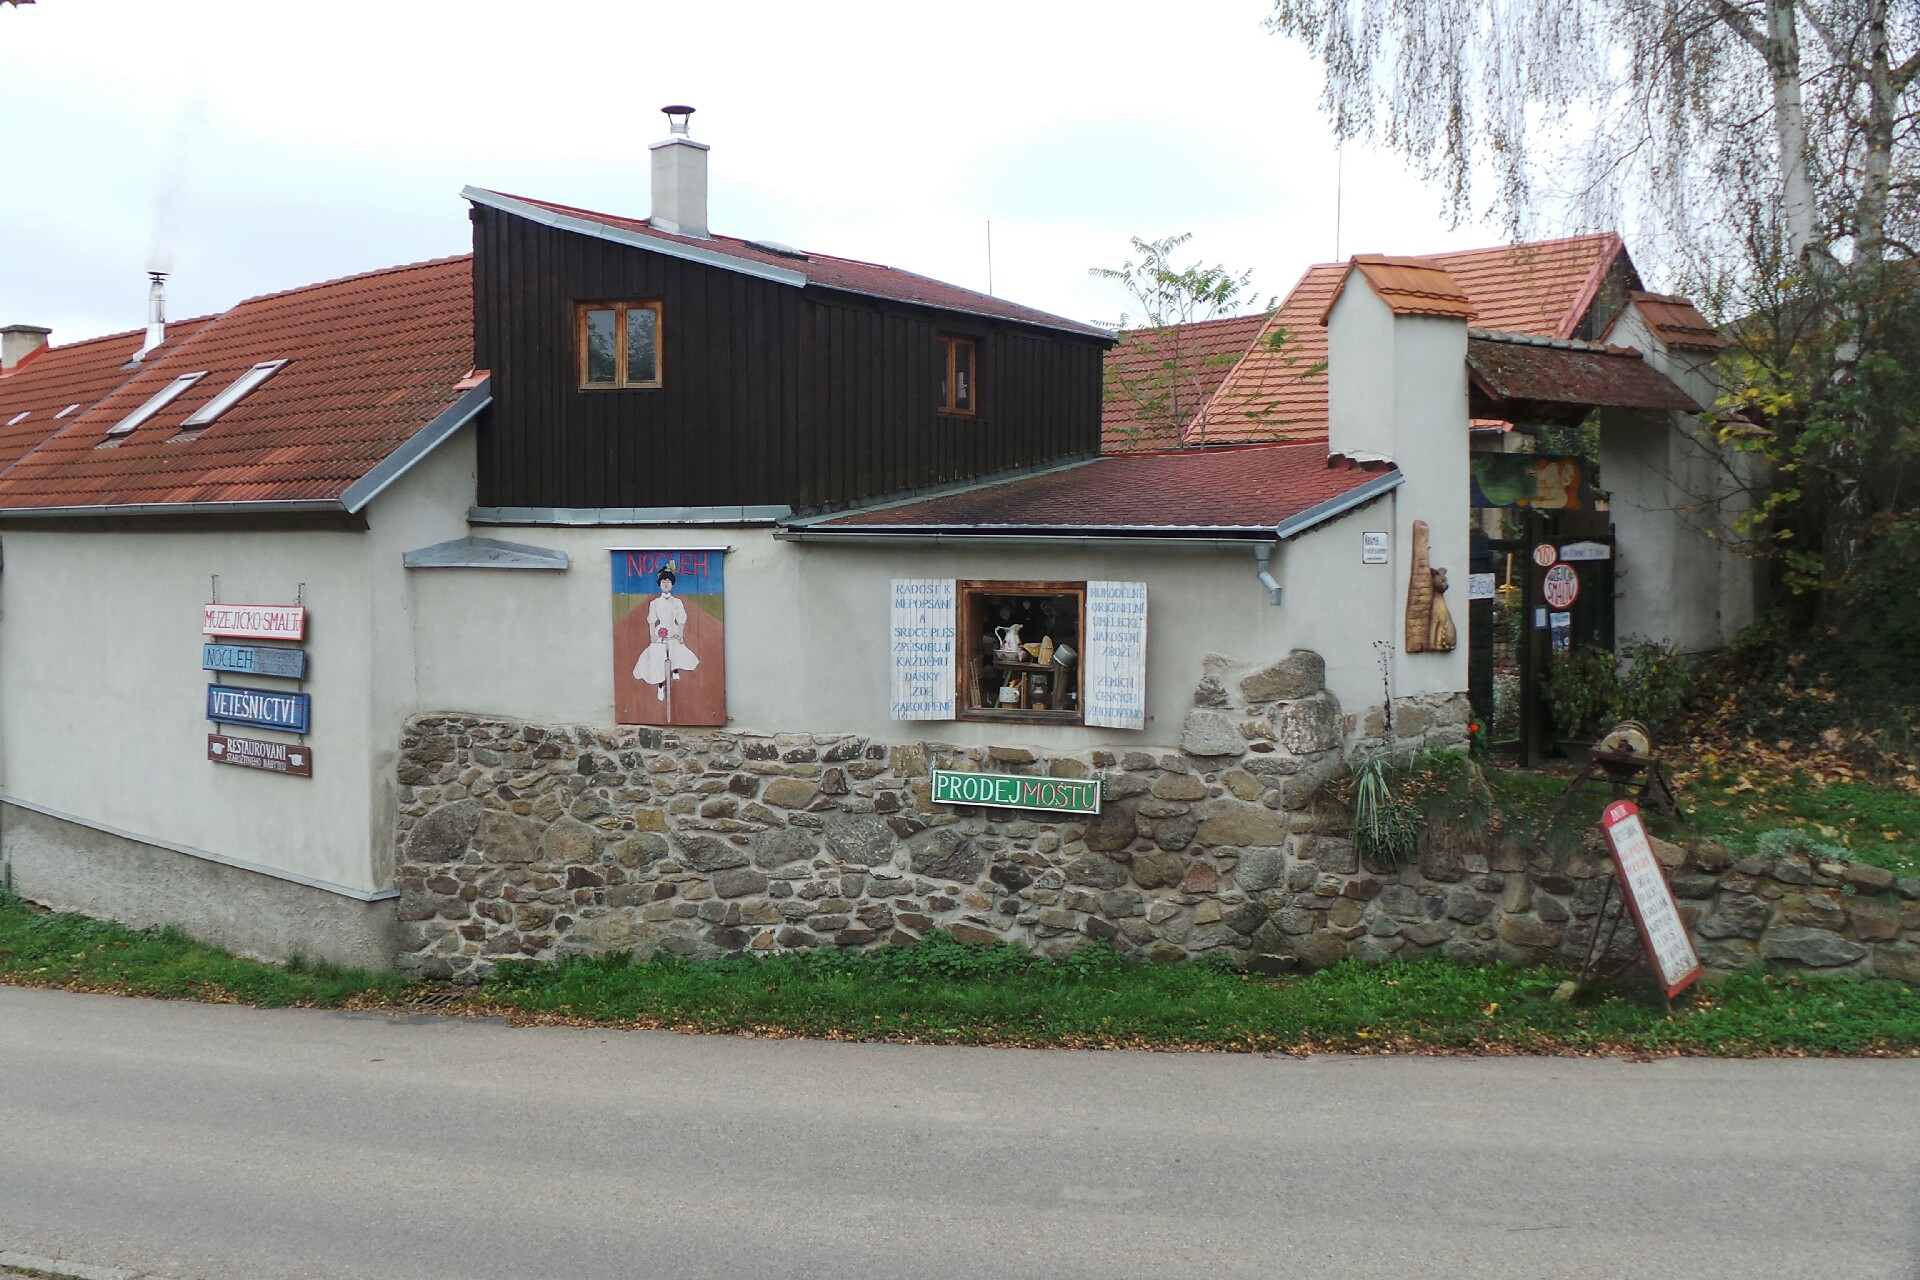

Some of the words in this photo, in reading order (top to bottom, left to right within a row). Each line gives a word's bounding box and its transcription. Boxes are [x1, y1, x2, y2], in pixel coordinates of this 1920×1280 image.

[627, 552, 708, 578] NOCLEH
[896, 584, 941, 595] RADOST
[944, 584, 951, 595] K
[919, 614, 926, 624] A
[894, 627, 927, 638] SRDCE
[931, 627, 955, 638] PLES
[206, 647, 254, 669] NOCLEH
[896, 655, 948, 667] KAŽDÉMU
[1112, 662, 1120, 672] V
[905, 670, 940, 682] DÁRKY
[911, 686, 933, 696] ZDE
[213, 690, 296, 724] VETEŠNICTVÍ
[936, 775, 1021, 803] PRODEJ
